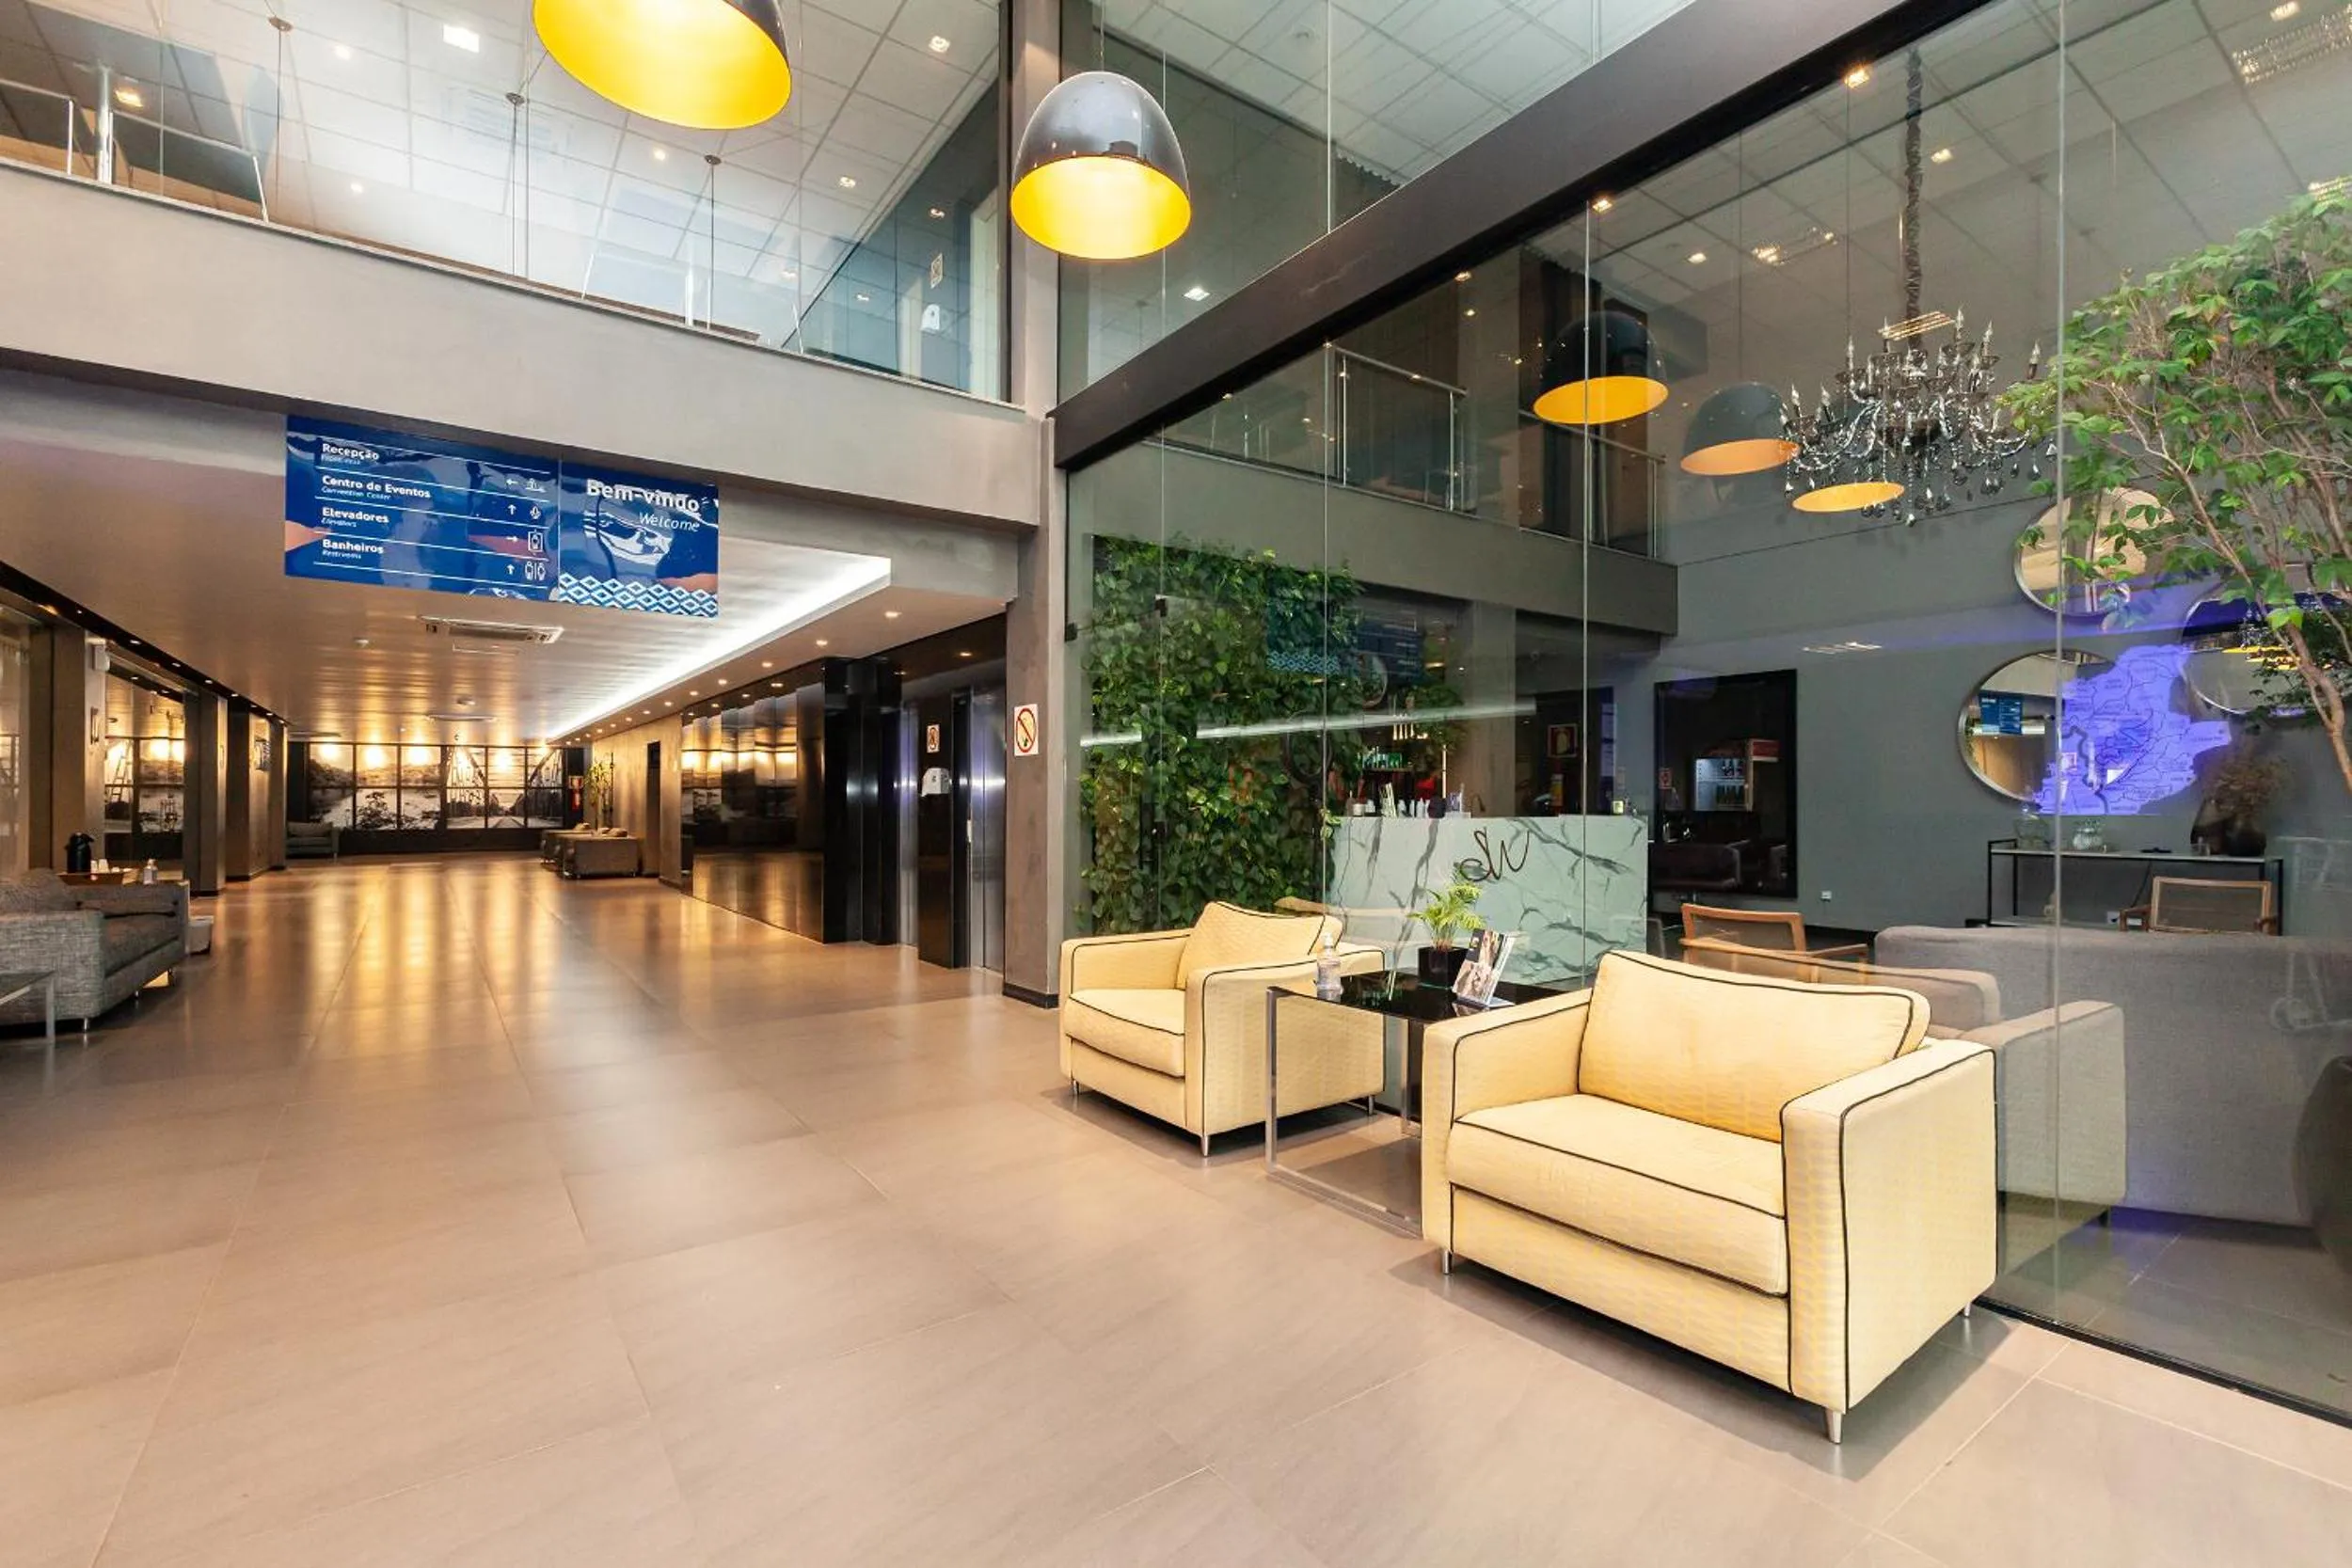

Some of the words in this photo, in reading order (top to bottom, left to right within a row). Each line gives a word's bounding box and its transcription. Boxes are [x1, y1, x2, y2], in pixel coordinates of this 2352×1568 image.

[322, 443, 379, 460] Recepção
[322, 475, 363, 489] Centro
[366, 482, 382, 491] de
[385, 483, 431, 499] Eventos
[586, 479, 700, 513] Bem-vindo
[322, 506, 389, 523] Elevadores
[639, 512, 700, 532] Welcome
[322, 539, 384, 554] Banheiros
